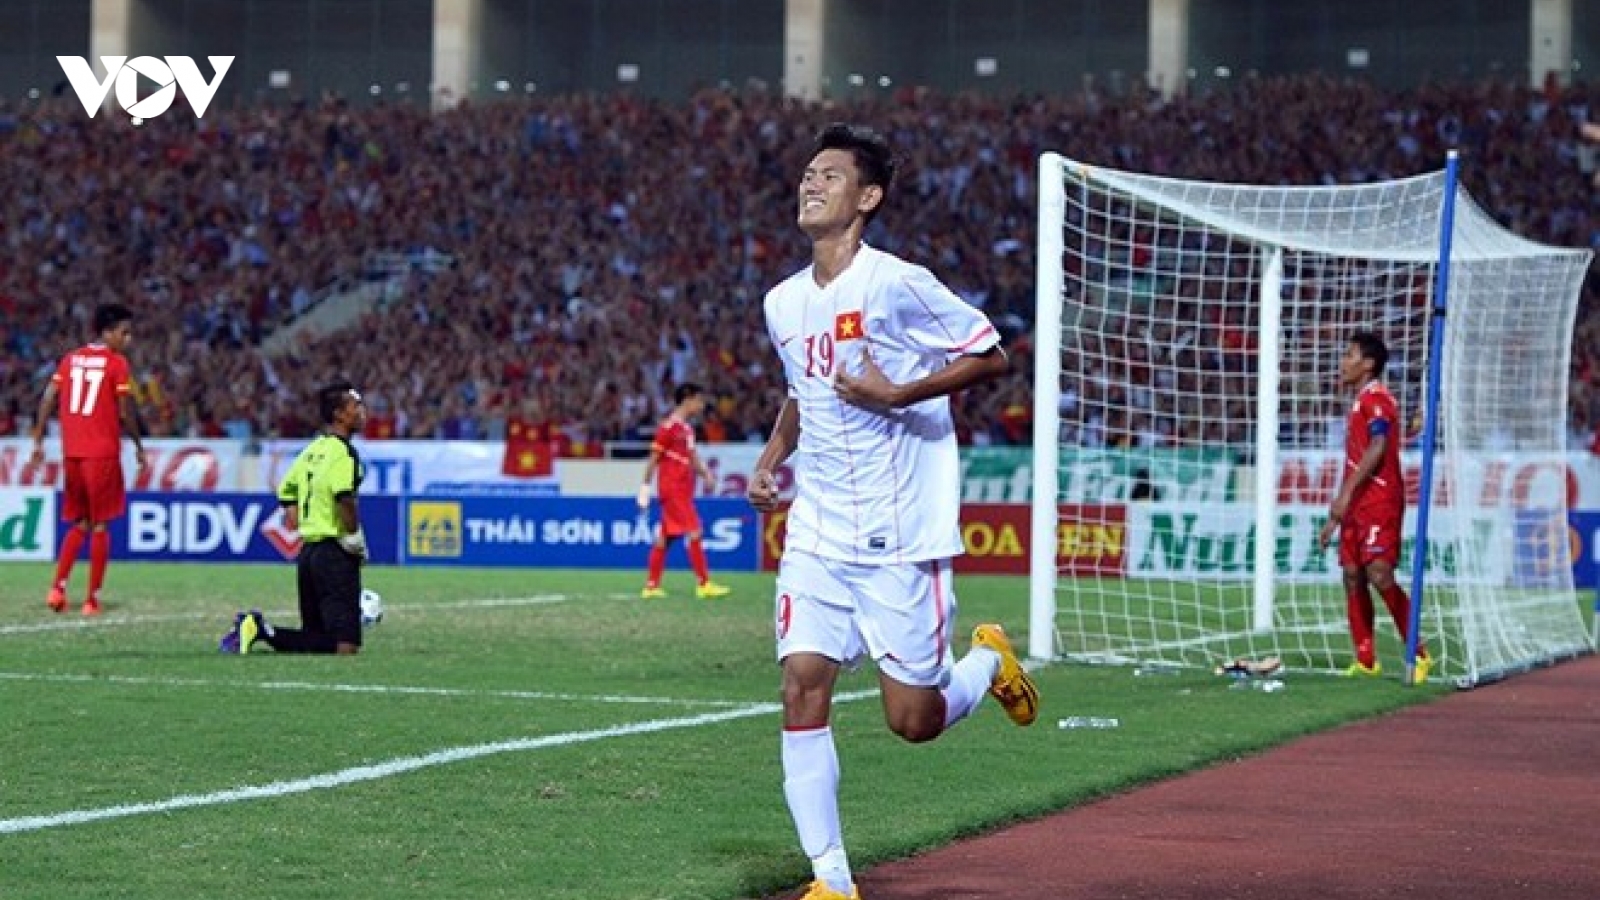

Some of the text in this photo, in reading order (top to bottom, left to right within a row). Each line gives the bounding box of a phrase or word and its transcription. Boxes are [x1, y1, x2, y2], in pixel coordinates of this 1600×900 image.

[804, 332, 834, 378] 19
[70, 368, 105, 416] 17
[129, 502, 263, 553] BIDV
[465, 514, 535, 544] THÁI
[542, 517, 604, 545] SƠN
[964, 522, 1122, 556] OA EN
